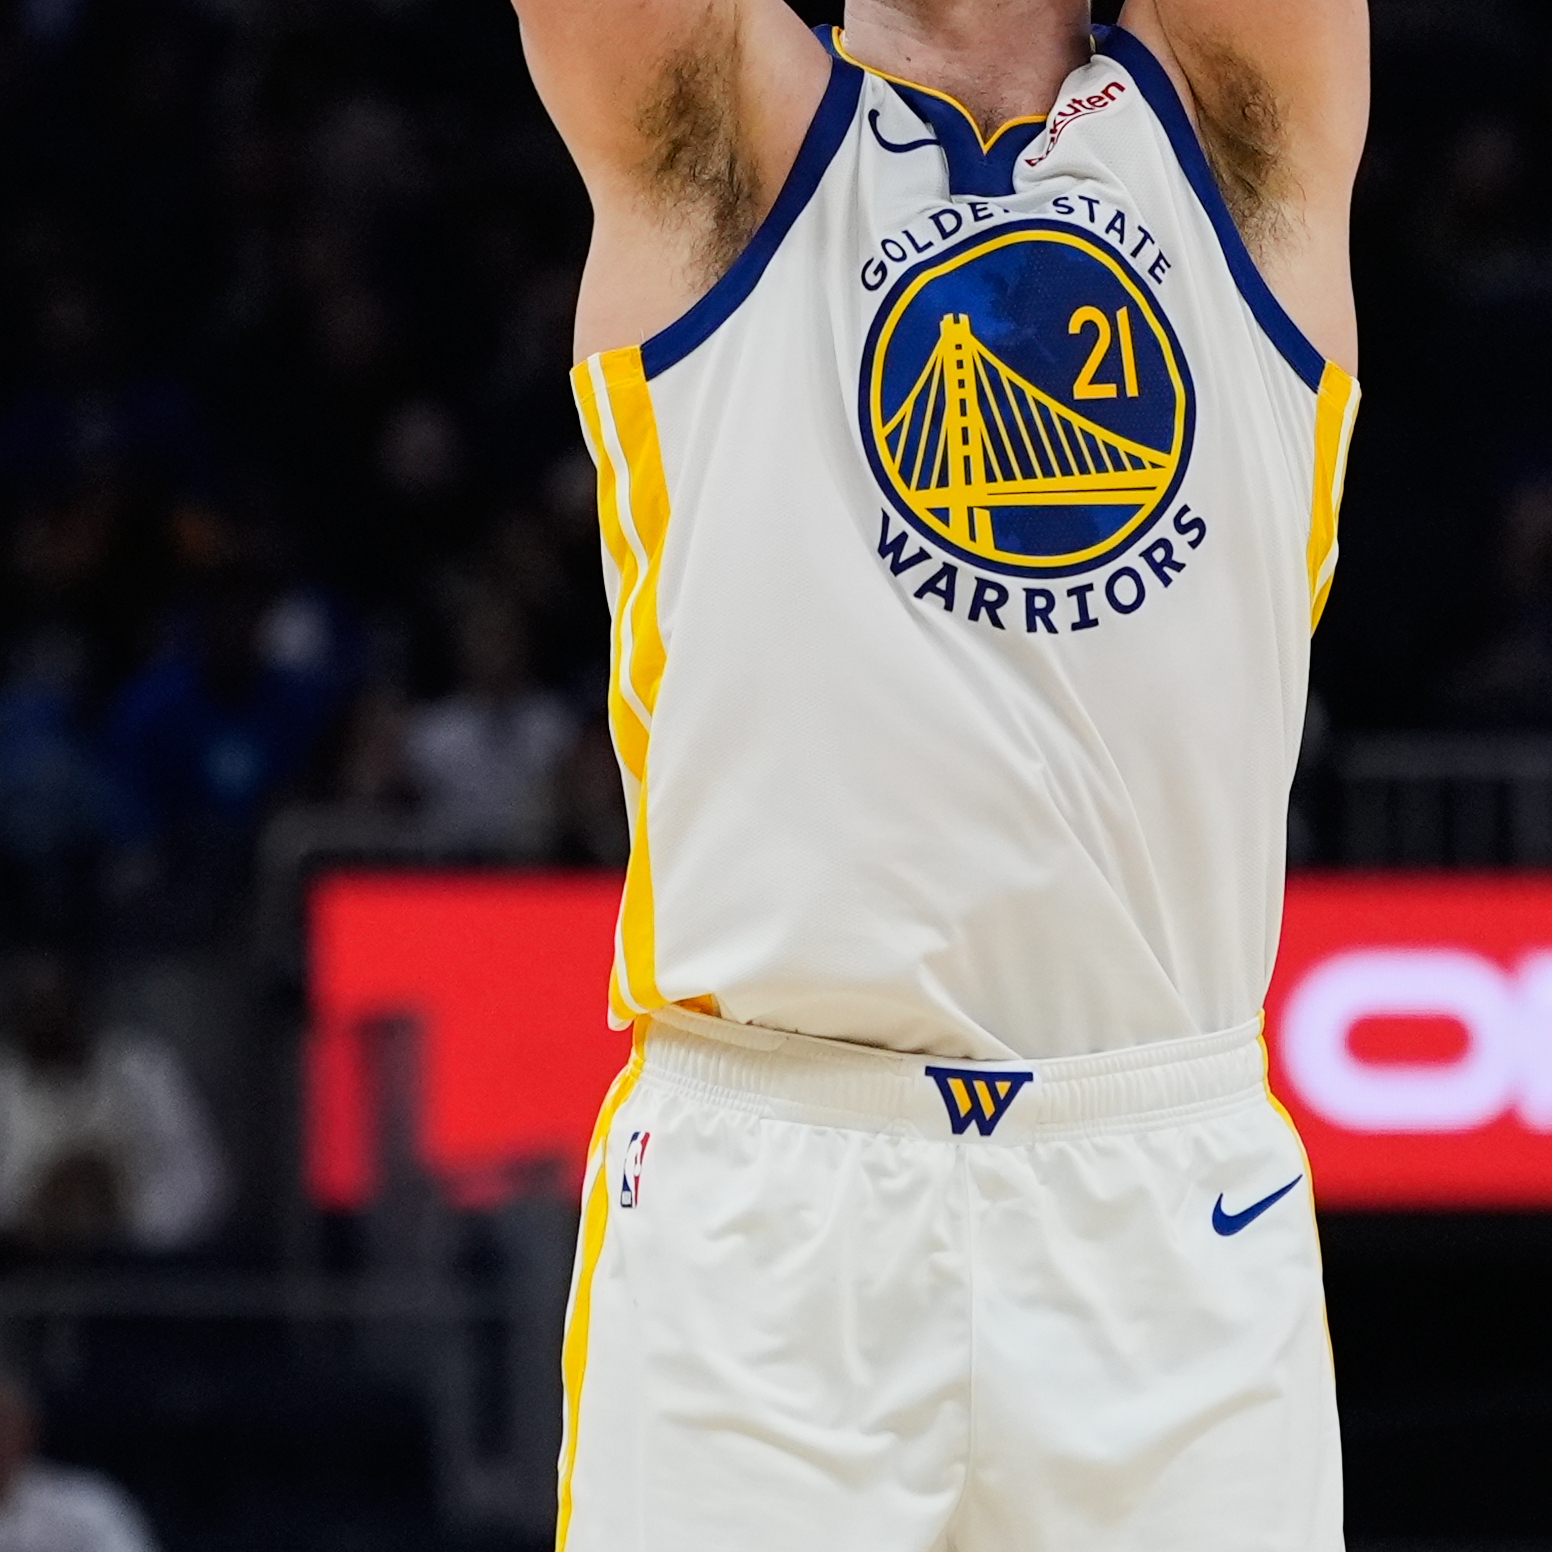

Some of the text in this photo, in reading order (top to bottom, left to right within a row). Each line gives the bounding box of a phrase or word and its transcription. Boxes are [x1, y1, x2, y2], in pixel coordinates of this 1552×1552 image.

[1024, 81, 1127, 168] kuten
[860, 194, 1172, 292] GOLDE STATE
[1067, 305, 1140, 400] 21
[876, 503, 1208, 636] WARRIORS
